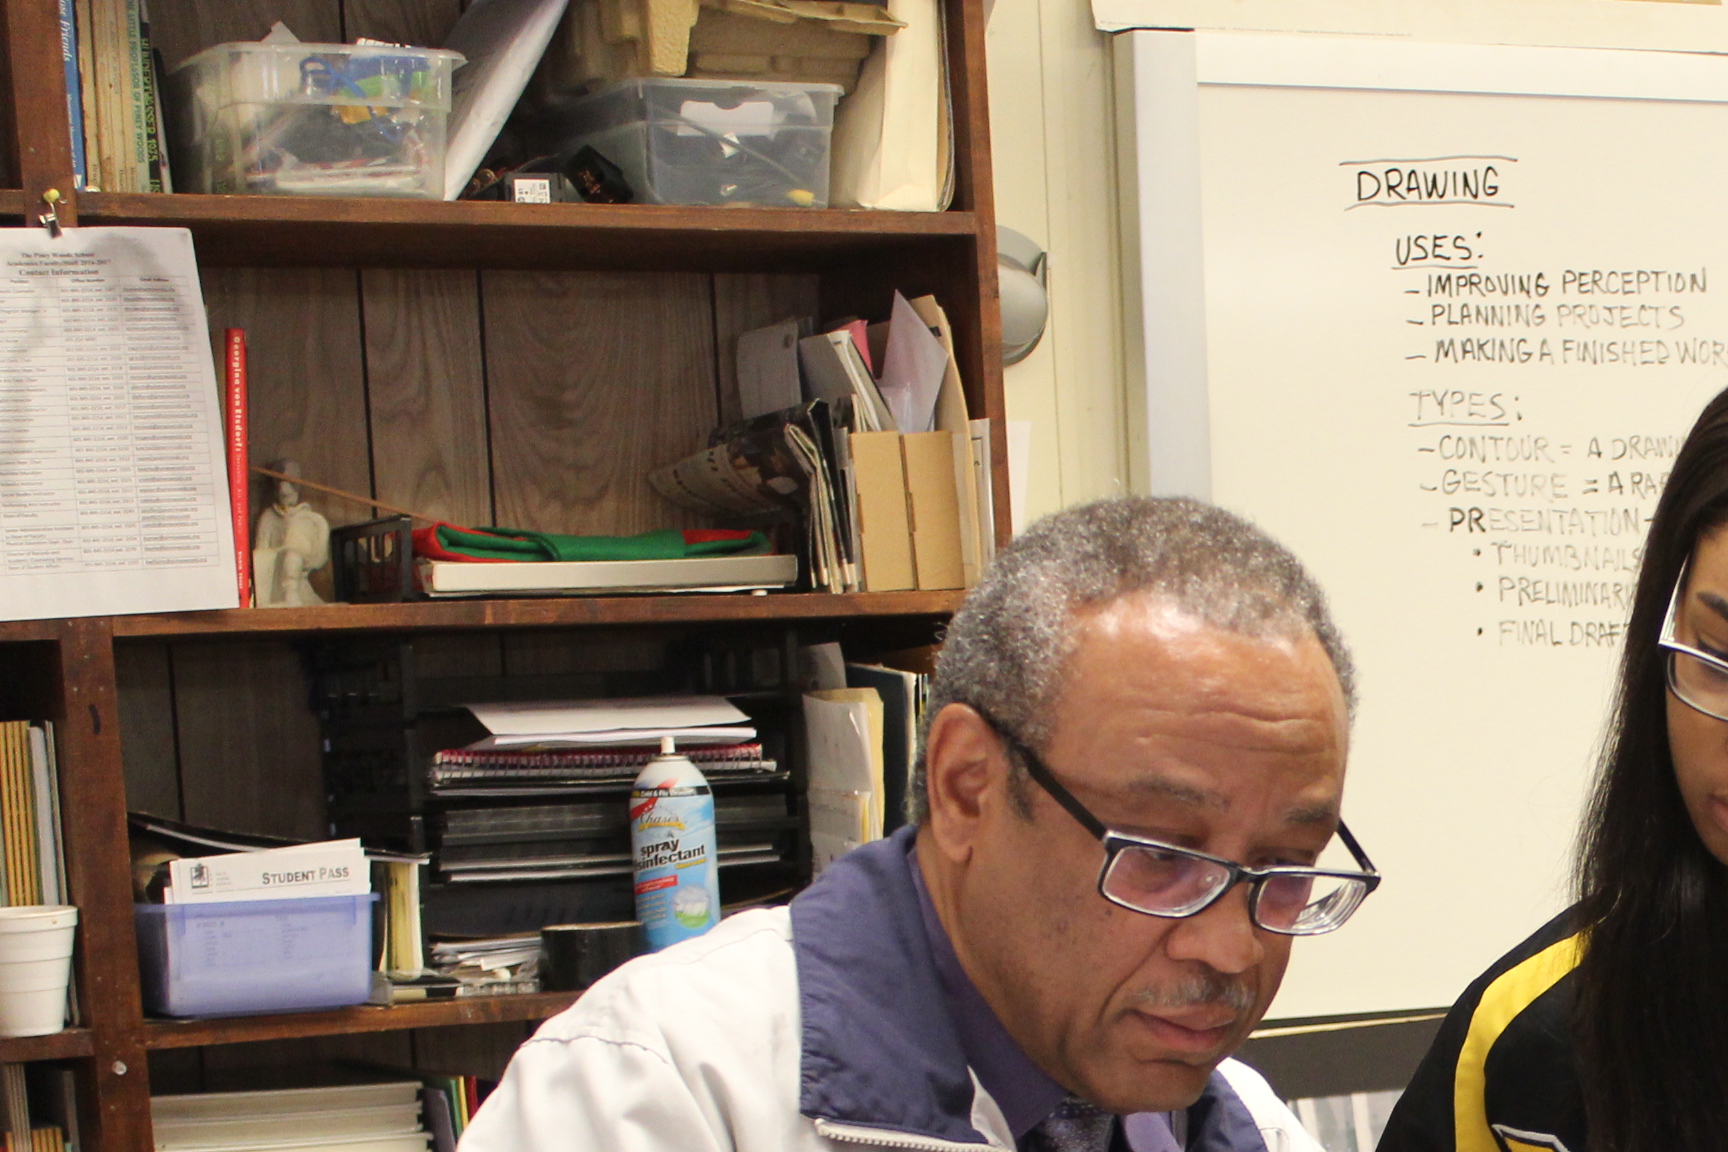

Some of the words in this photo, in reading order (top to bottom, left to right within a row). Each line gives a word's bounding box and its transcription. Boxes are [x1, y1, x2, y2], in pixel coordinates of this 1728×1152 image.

[60, 19, 72, 62] Friends
[1356, 166, 1500, 202] DRAWING
[1394, 231, 1485, 266] USES:
[1427, 272, 1549, 298] IMPROVING
[1562, 268, 1707, 295] PERCEPTION
[1430, 303, 1546, 328] PLANNING
[1556, 303, 1686, 331] PROJECTS
[232, 336, 242, 386] Georgina
[1435, 338, 1533, 364] MAKING
[1538, 341, 1556, 366] A
[1562, 338, 1670, 367] FINISHED
[1409, 389, 1522, 421] TYPES:
[1438, 434, 1555, 463] CONTOUR
[1587, 437, 1602, 459] A
[1612, 434, 1688, 460] DRAWI
[1442, 469, 1568, 502] GESTURE
[1608, 470, 1623, 495] A
[1449, 506, 1641, 536] PRESENTATION
[1491, 540, 1642, 571] THUMBNAILS
[1499, 619, 1561, 646] FINAL
[635, 844, 706, 872] sinfectant
[640, 839, 681, 859] spray
[262, 870, 316, 886] STUDENT
[319, 867, 350, 881] PASS
